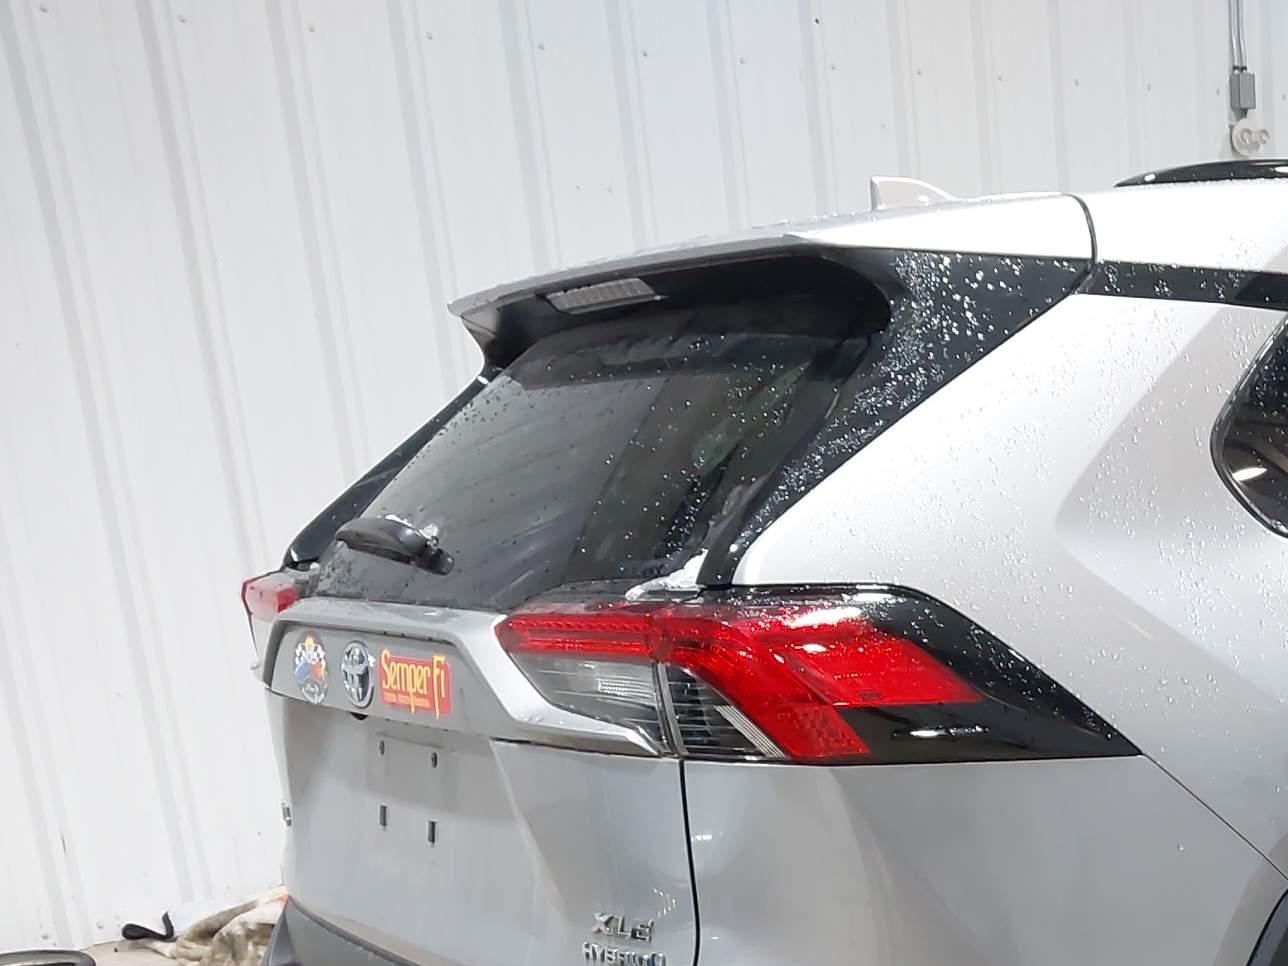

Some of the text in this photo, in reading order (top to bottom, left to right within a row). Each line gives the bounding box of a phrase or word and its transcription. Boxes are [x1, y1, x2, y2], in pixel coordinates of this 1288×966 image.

[381, 649, 446, 720] Semper Fi
[592, 912, 655, 942] XLE
